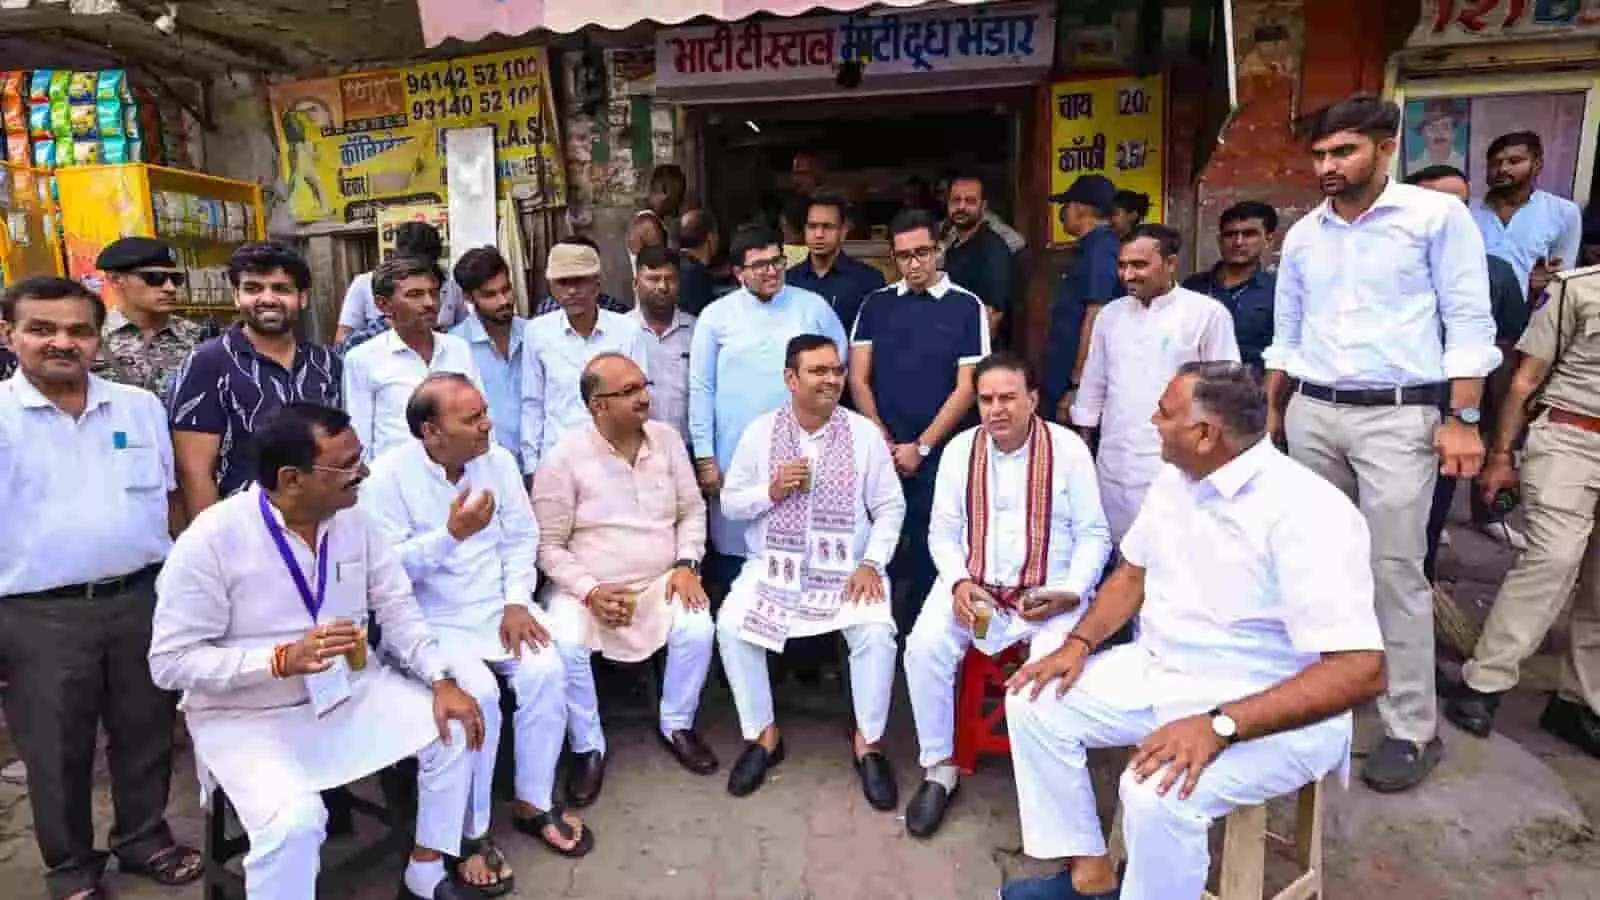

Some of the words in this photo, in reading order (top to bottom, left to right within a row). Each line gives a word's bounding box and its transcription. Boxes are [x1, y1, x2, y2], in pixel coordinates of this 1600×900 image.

[665, 25, 734, 73] भाटी
[764, 29, 837, 69] स्टाल
[406, 66, 468, 95] 94142
[472, 63, 499, 86] 52
[413, 94, 473, 120] 93140
[479, 90, 503, 113] 52
